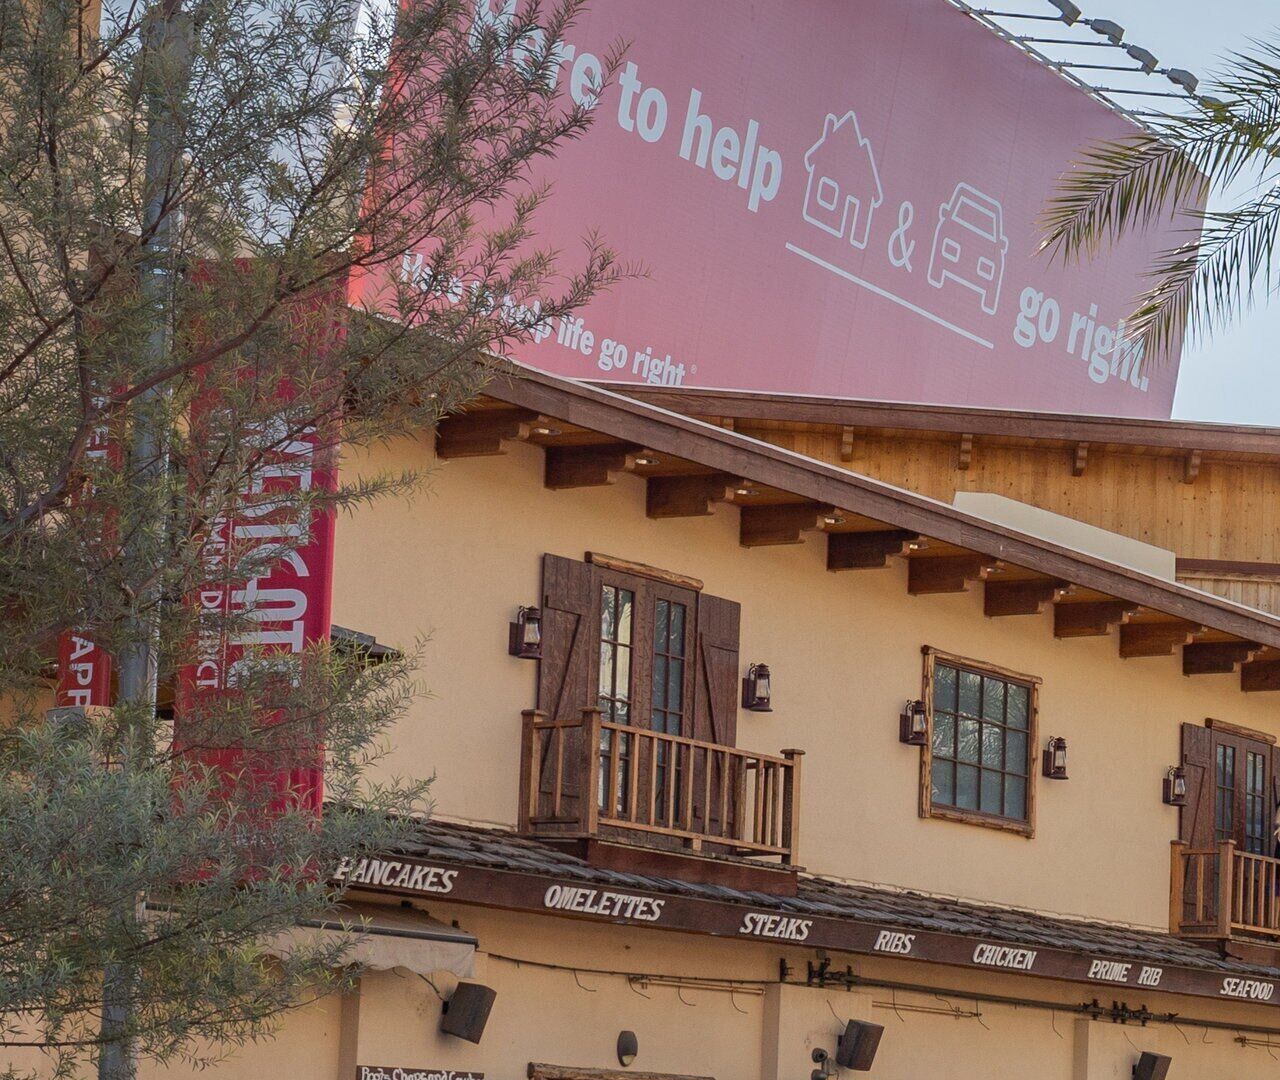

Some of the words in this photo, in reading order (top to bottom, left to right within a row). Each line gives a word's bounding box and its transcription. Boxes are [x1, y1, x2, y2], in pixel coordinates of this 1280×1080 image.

[618, 61, 667, 143] to
[679, 88, 782, 213] help
[1013, 287, 1060, 348] go
[557, 315, 594, 355] life
[598, 338, 627, 371] go
[334, 857, 458, 893] PANCAKES
[544, 885, 665, 922] OMELETTES
[739, 913, 813, 941] STEAKS
[875, 930, 916, 954] RIBS
[972, 943, 1037, 970] CHICKEN
[1088, 960, 1131, 983] PRIME
[1138, 966, 1162, 986] RIB
[1220, 978, 1274, 1000] SEAFOOD
